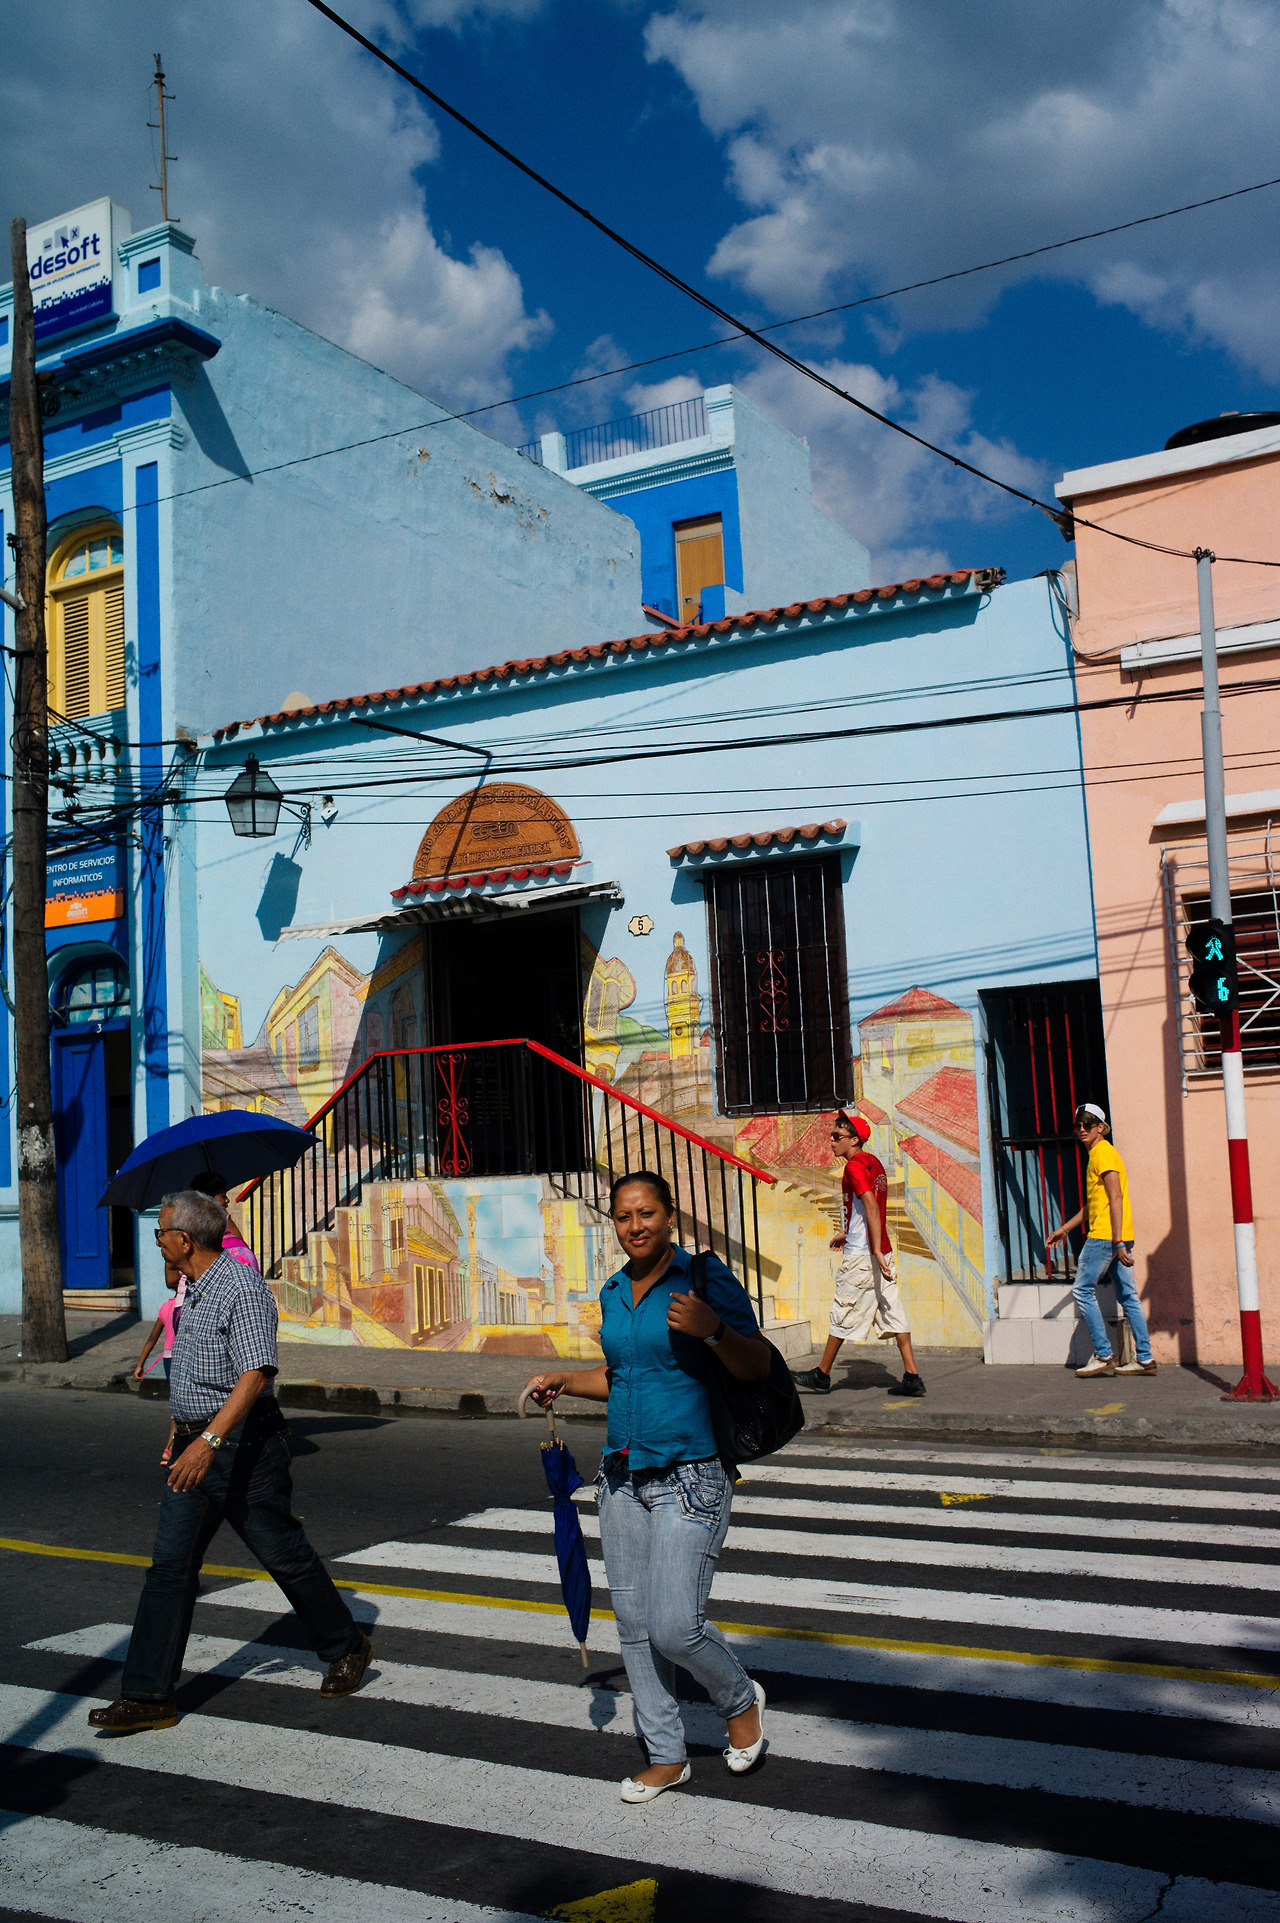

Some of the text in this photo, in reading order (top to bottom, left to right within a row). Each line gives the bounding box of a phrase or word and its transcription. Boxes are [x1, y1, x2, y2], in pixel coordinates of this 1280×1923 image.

[30, 233, 100, 280] desoft
[415, 838, 434, 873] Patio
[517, 842, 551, 857] CULTURAL
[46, 855, 115, 874] ENTRO DE SERVICIOS
[637, 919, 644, 931] 5
[1217, 976, 1229, 1001] 6
[96, 1023, 102, 1034] 3
